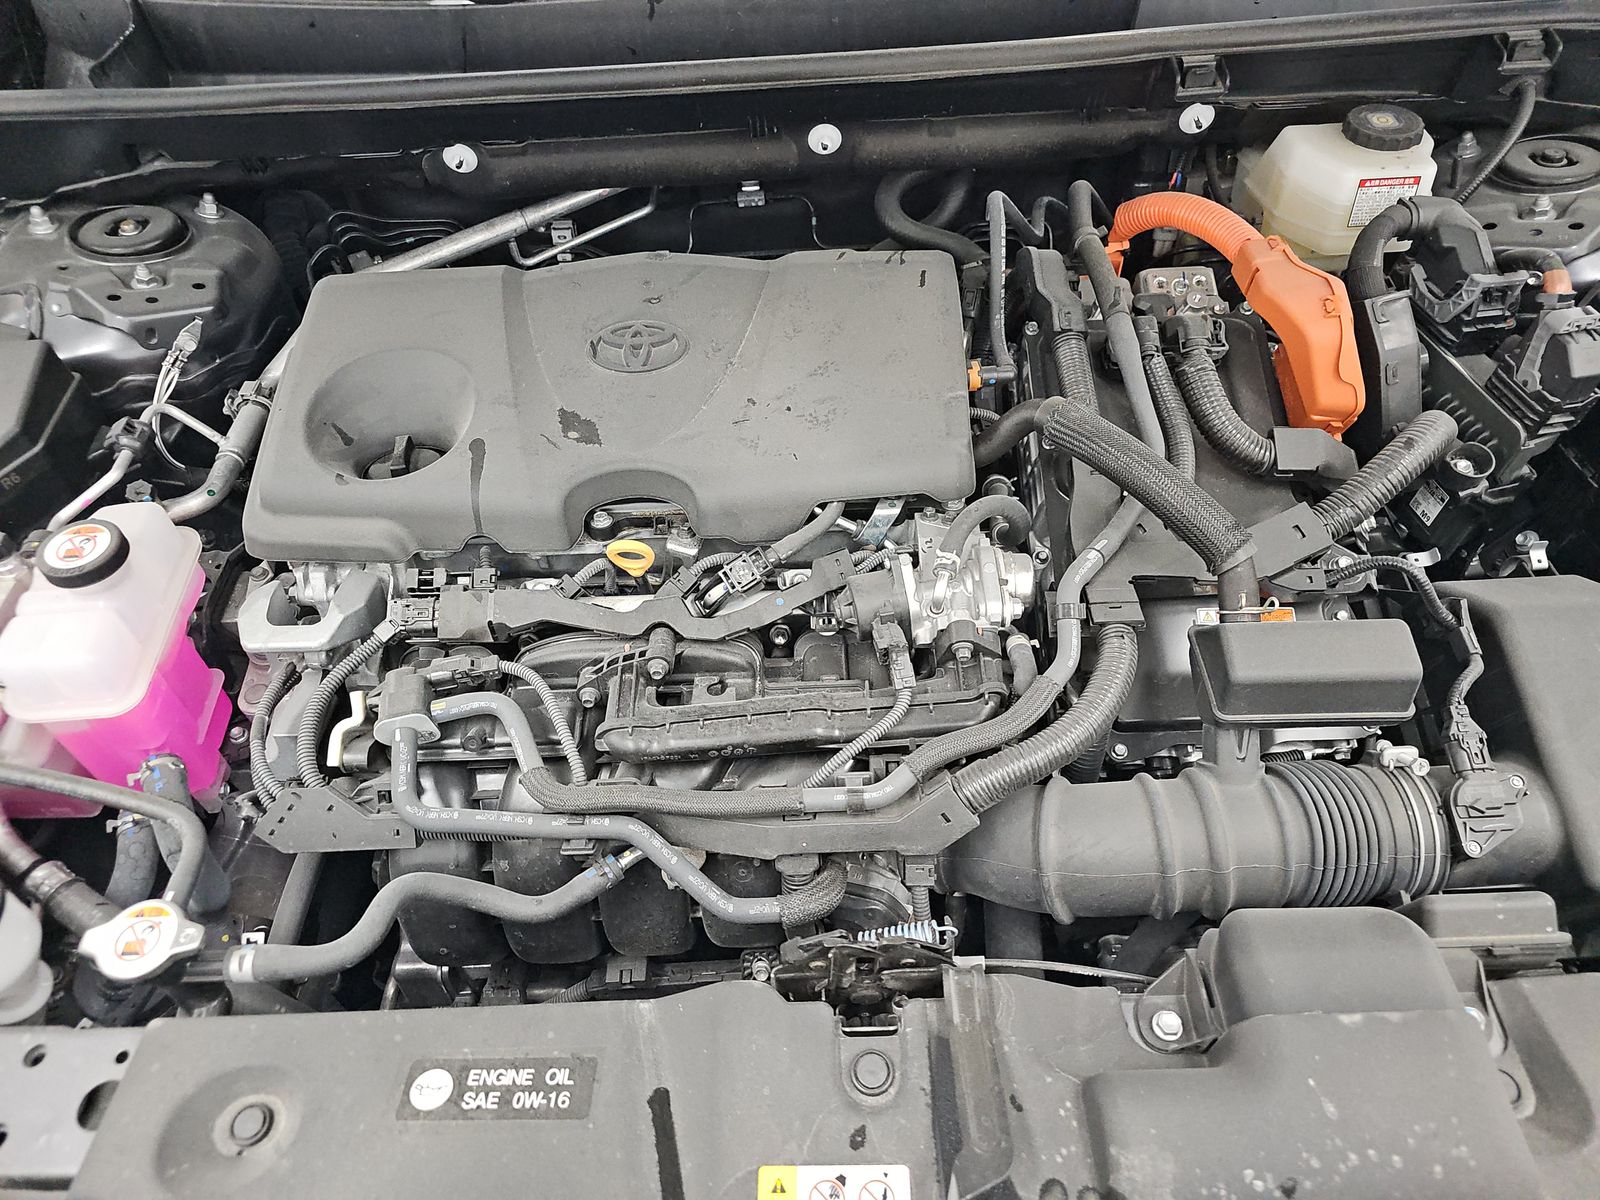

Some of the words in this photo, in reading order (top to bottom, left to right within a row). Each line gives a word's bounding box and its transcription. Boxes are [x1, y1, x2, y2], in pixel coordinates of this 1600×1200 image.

[1419, 509, 1431, 522] M9
[466, 1067, 535, 1086] ENGINE
[545, 1067, 574, 1086] OIL
[461, 1091, 501, 1110] SAE
[512, 1090, 571, 1109] 0W-16
